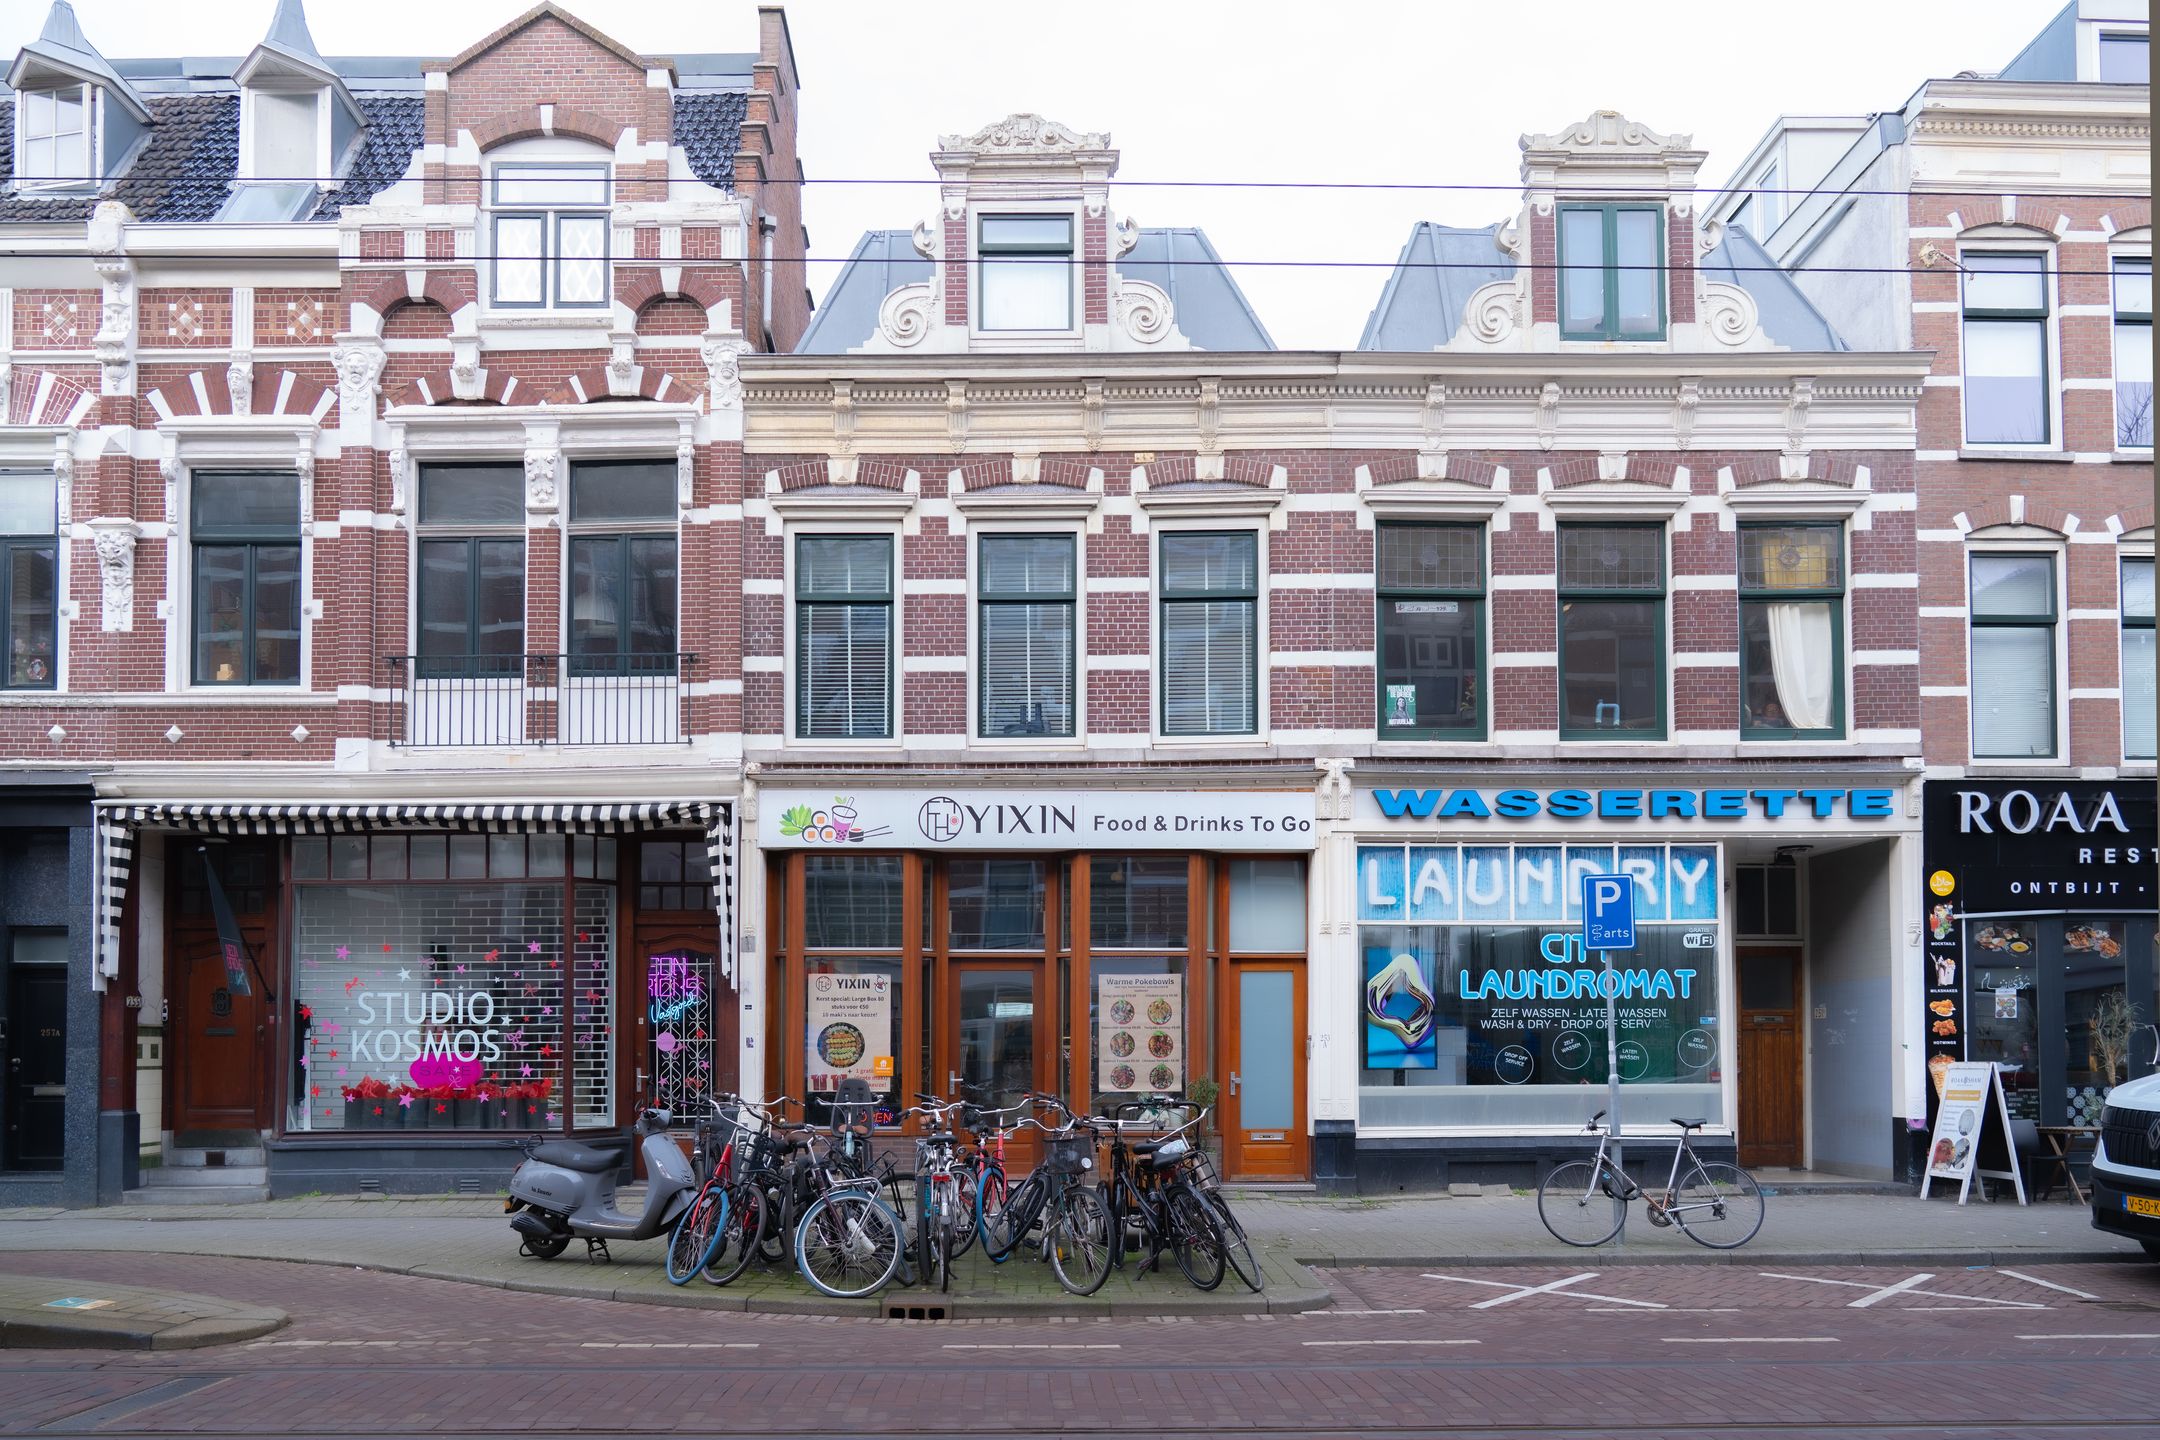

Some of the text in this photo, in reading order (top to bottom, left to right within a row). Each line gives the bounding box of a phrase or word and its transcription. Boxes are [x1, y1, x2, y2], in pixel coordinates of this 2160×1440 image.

[1373, 788, 1894, 819] WASSERETTE
[1956, 789, 2131, 835] ROAA
[964, 804, 1076, 834] YIXIN
[1093, 815, 1311, 832] Food & Drinks To Go
[1367, 858, 1709, 906] LAUNDRY
[2010, 881, 2120, 894] ONTBIJT
[1595, 880, 1622, 918] P
[1603, 928, 1630, 938] arts
[836, 978, 871, 990] YIXIN
[1460, 968, 1697, 1000] LAUNDROMAT
[357, 991, 495, 1025] STUDIO
[1491, 1008, 1519, 1018] ZELF
[1521, 1008, 1570, 1018] WASSEN
[1618, 1008, 1667, 1018] WASSEN
[1480, 1019, 1516, 1029] WASH
[1516, 1019, 1525, 1029] &
[1527, 1019, 1551, 1029] DRY
[1561, 1019, 1593, 1029] DROP
[40, 1028, 61, 1037] 257A
[351, 1029, 501, 1063] KOSMOS
[1561, 1042, 1582, 1053] WASSEN
[1563, 1038, 1574, 1046] ZELF
[1687, 1042, 1708, 1050] WASSEN
[1504, 1051, 1518, 1059] DROP
[1505, 1057, 1525, 1067] SERVICE
